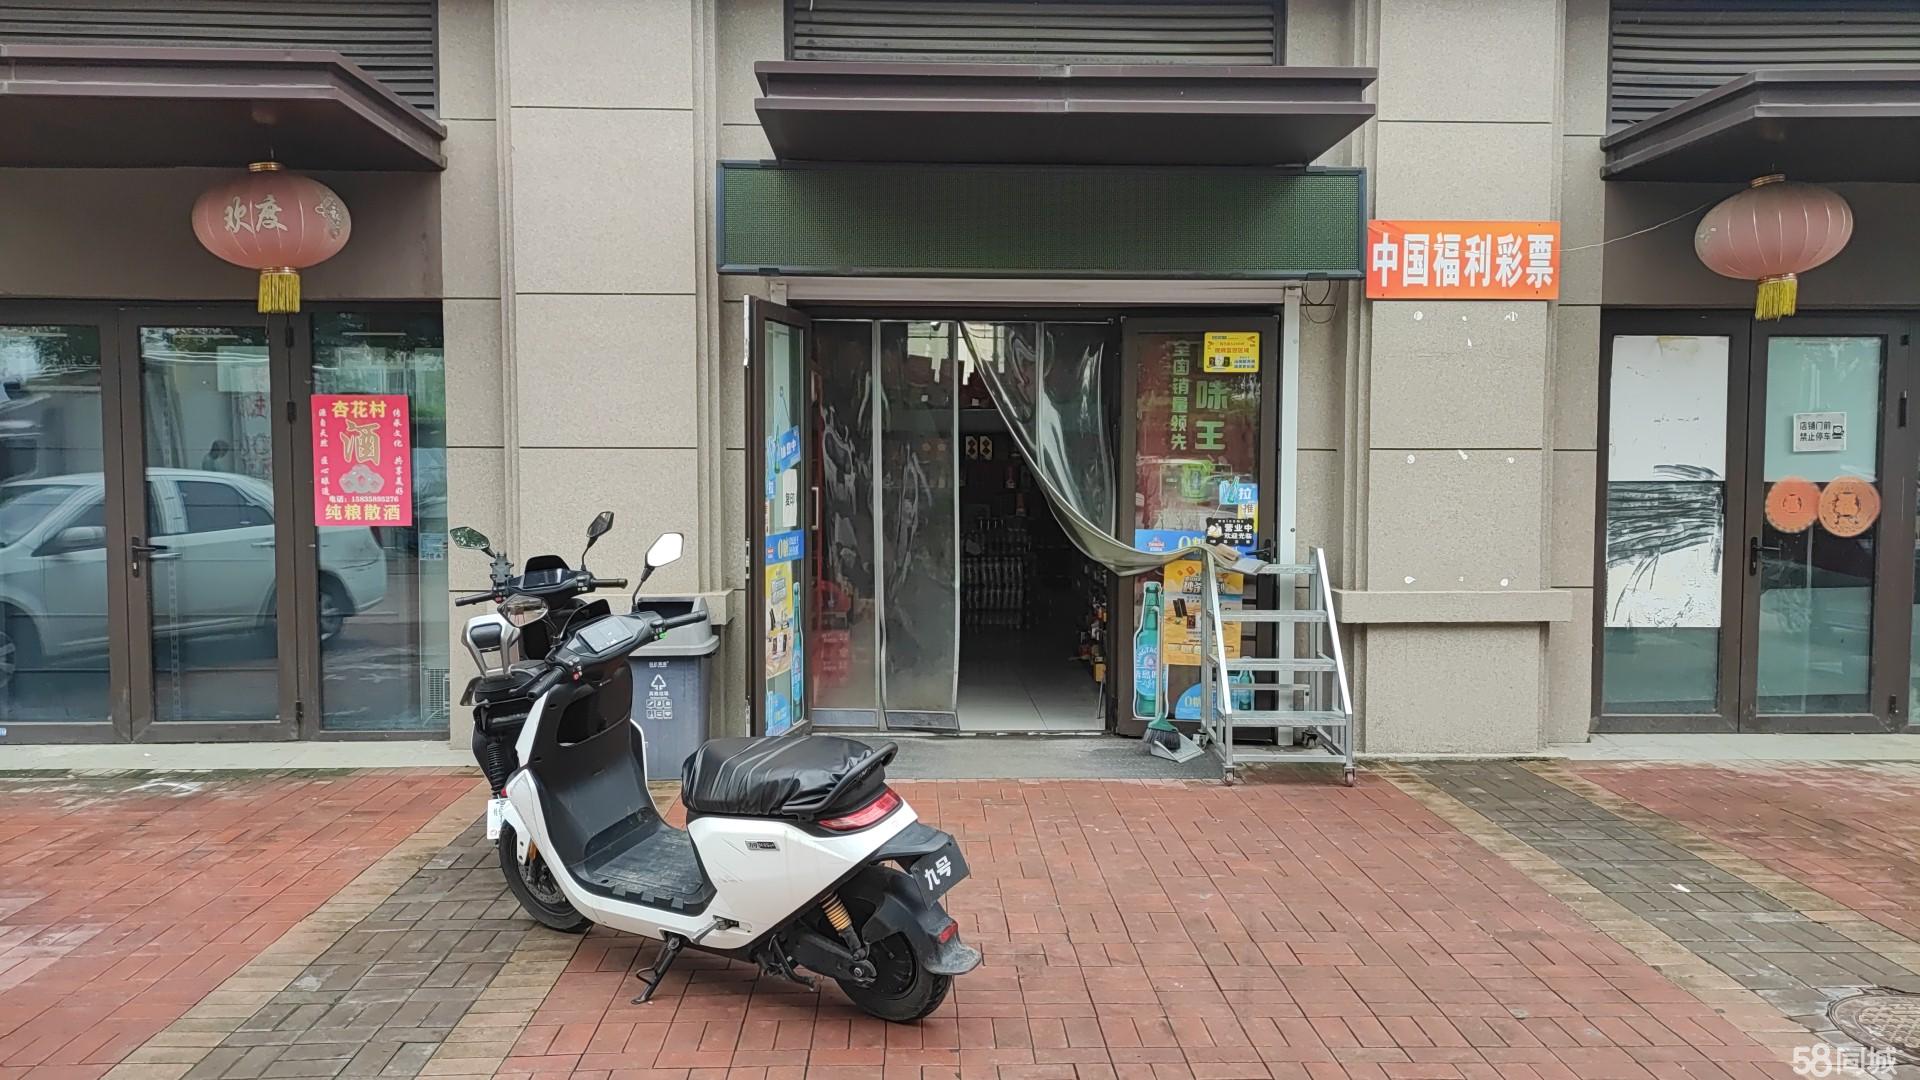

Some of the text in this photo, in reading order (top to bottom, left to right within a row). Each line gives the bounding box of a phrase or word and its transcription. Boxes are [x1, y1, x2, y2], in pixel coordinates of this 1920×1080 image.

[223, 194, 288, 234] 欢度
[1372, 231, 1554, 289] 中国福利彩票
[1170, 340, 1190, 451] 全国销量领先
[1195, 342, 1229, 450] 味王
[331, 400, 387, 418] 杏花村
[1799, 421, 1831, 431] 店铺门前
[340, 418, 380, 467] 酒
[1799, 432, 1831, 442] 禁止停车
[1239, 487, 1252, 500] 拉
[325, 503, 401, 521] 纯粮散酒
[1242, 503, 1254, 515] 推
[1223, 524, 1253, 533] 营业中
[1223, 532, 1253, 540] 欢迎光临
[924, 855, 952, 890] 九号
